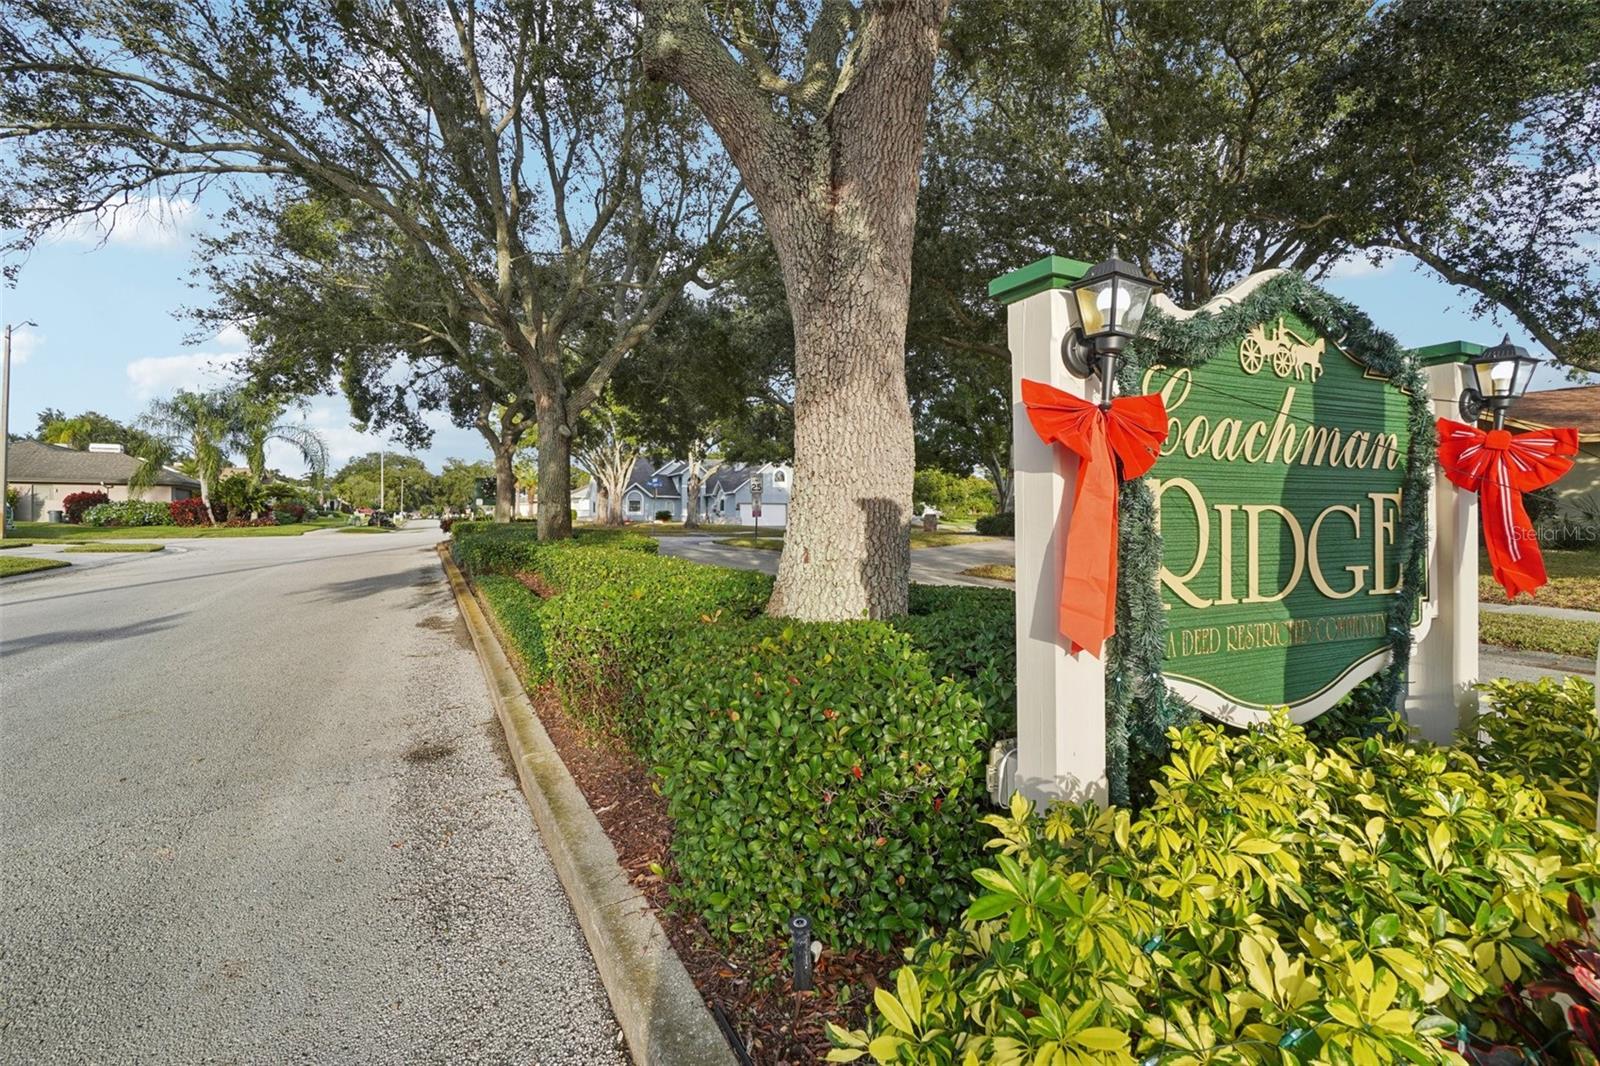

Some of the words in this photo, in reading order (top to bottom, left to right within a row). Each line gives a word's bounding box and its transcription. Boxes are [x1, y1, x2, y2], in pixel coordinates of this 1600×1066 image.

[1142, 364, 1402, 471] Coachman
[1146, 477, 1403, 610] RIDGE
[1167, 632, 1177, 658] A
[1181, 627, 1221, 657] DEED
